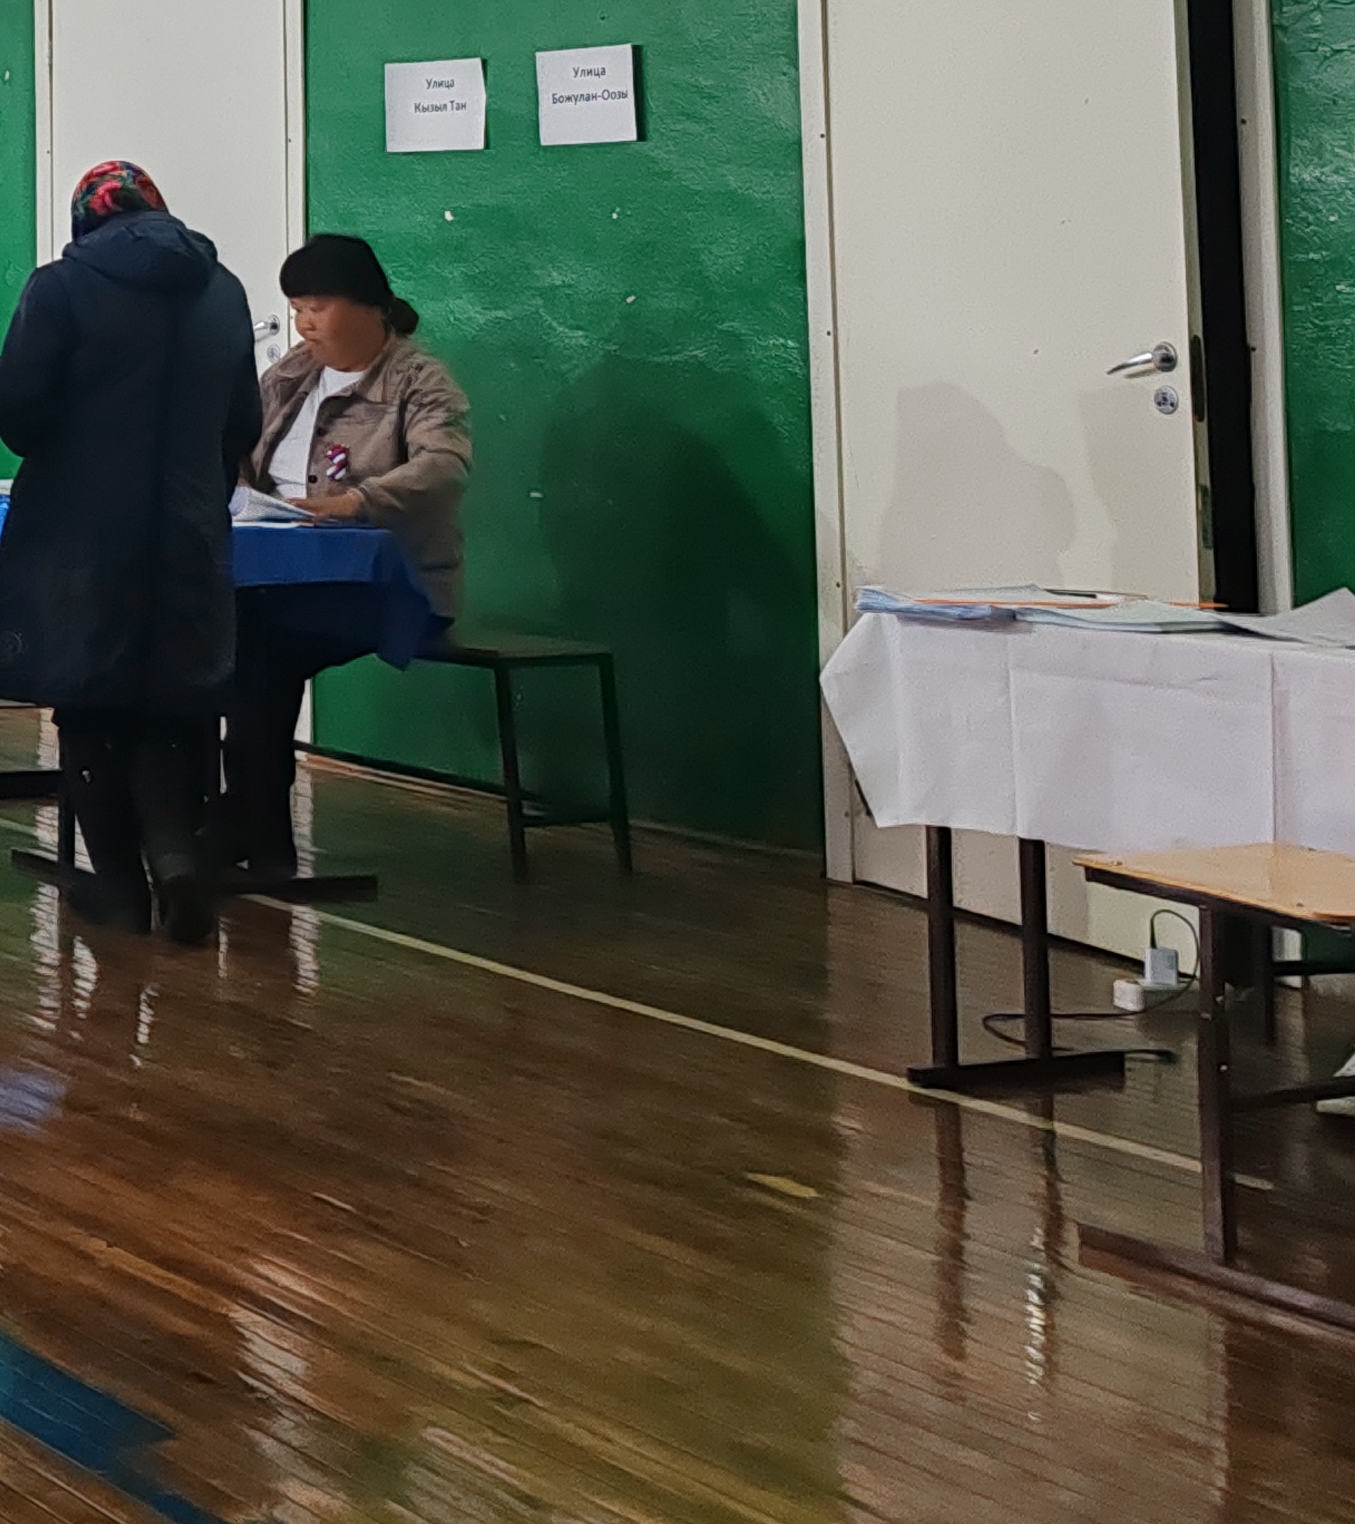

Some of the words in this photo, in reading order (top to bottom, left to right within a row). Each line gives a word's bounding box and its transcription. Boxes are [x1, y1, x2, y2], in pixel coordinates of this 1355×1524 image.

[572, 66, 606, 79] Улица
[425, 78, 455, 90] Улица
[551, 89, 628, 106] Божулан-Оозы
[414, 102, 448, 113] Кызыл
[449, 100, 467, 112] Тан
